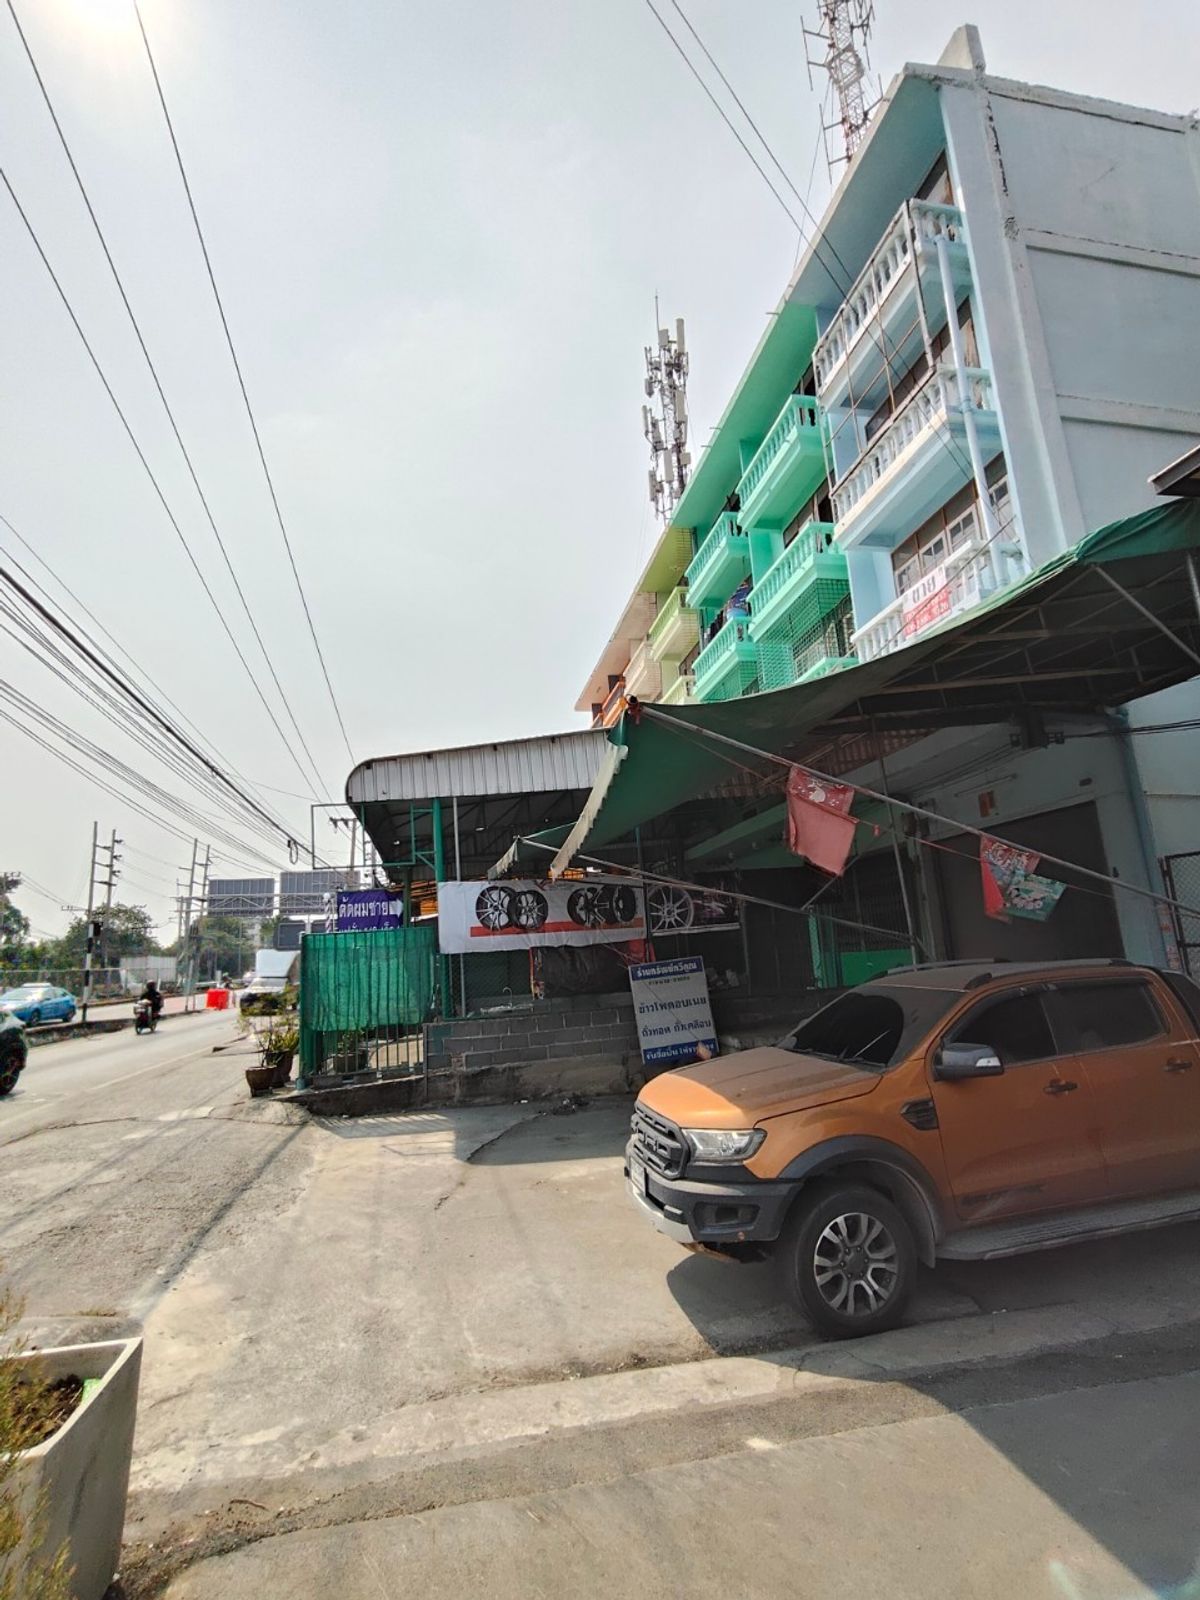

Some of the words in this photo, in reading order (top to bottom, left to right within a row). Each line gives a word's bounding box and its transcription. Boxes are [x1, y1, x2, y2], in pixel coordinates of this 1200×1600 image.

[339, 896, 388, 917] ตัดผมชาย
[639, 997, 707, 1013] ข้าวโพดอบเนย
[641, 1024, 671, 1037] ถั่วทอด
